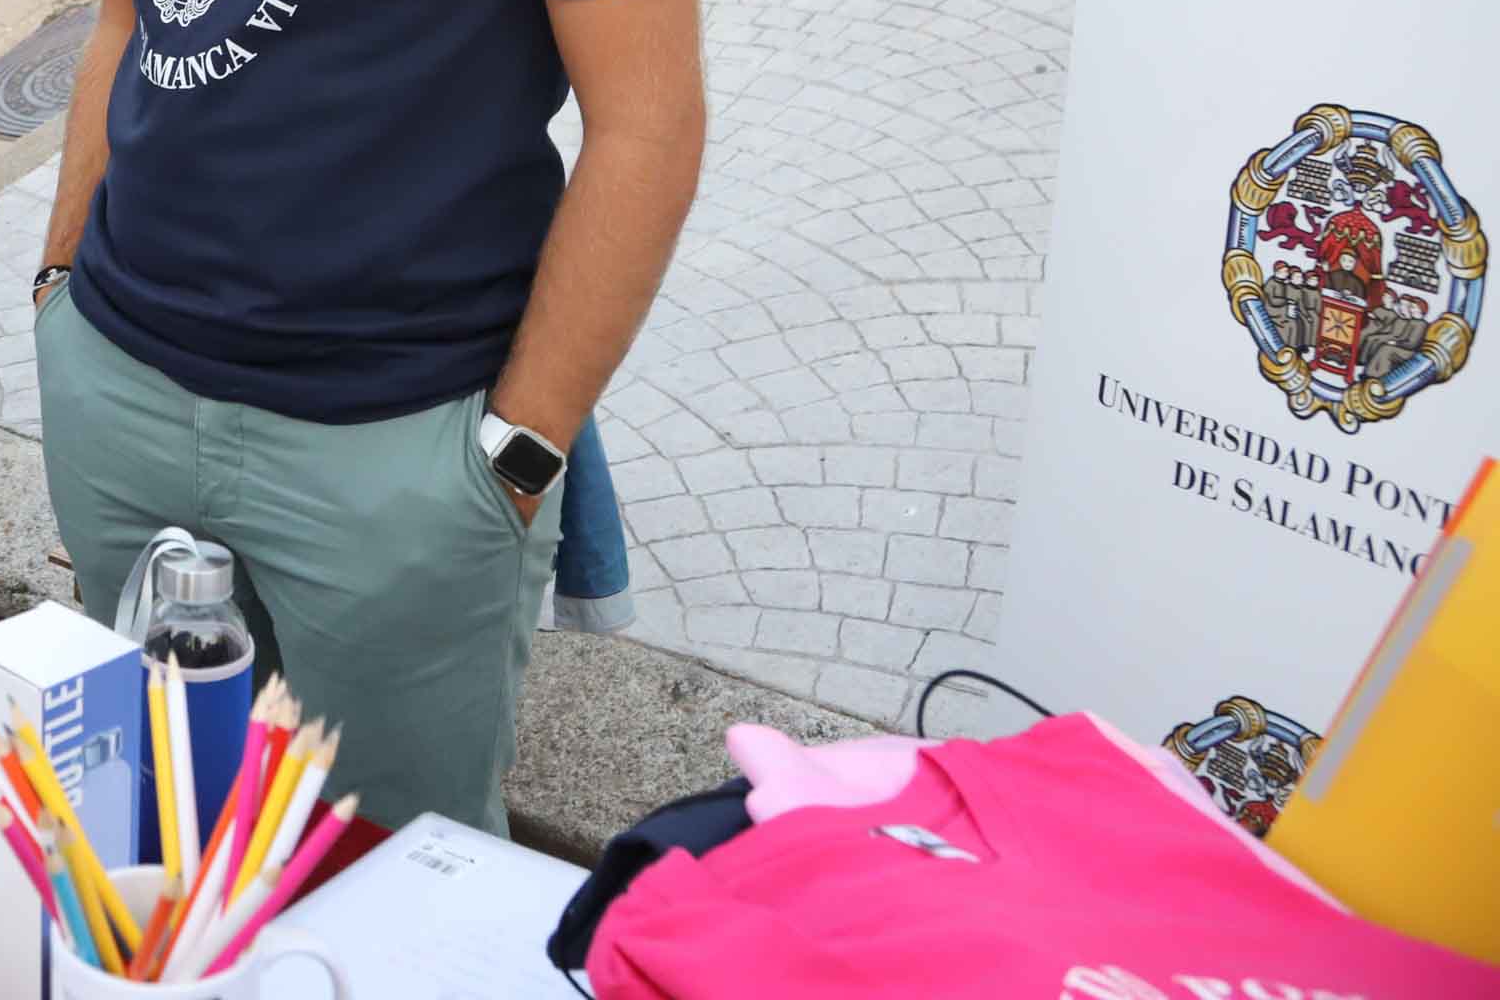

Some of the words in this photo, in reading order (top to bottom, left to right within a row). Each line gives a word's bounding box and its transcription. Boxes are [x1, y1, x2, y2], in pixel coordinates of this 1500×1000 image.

[140, 37, 257, 90] AMANCA
[1097, 373, 1331, 485] UNIVERSIDAD
[1172, 459, 1220, 501] DE
